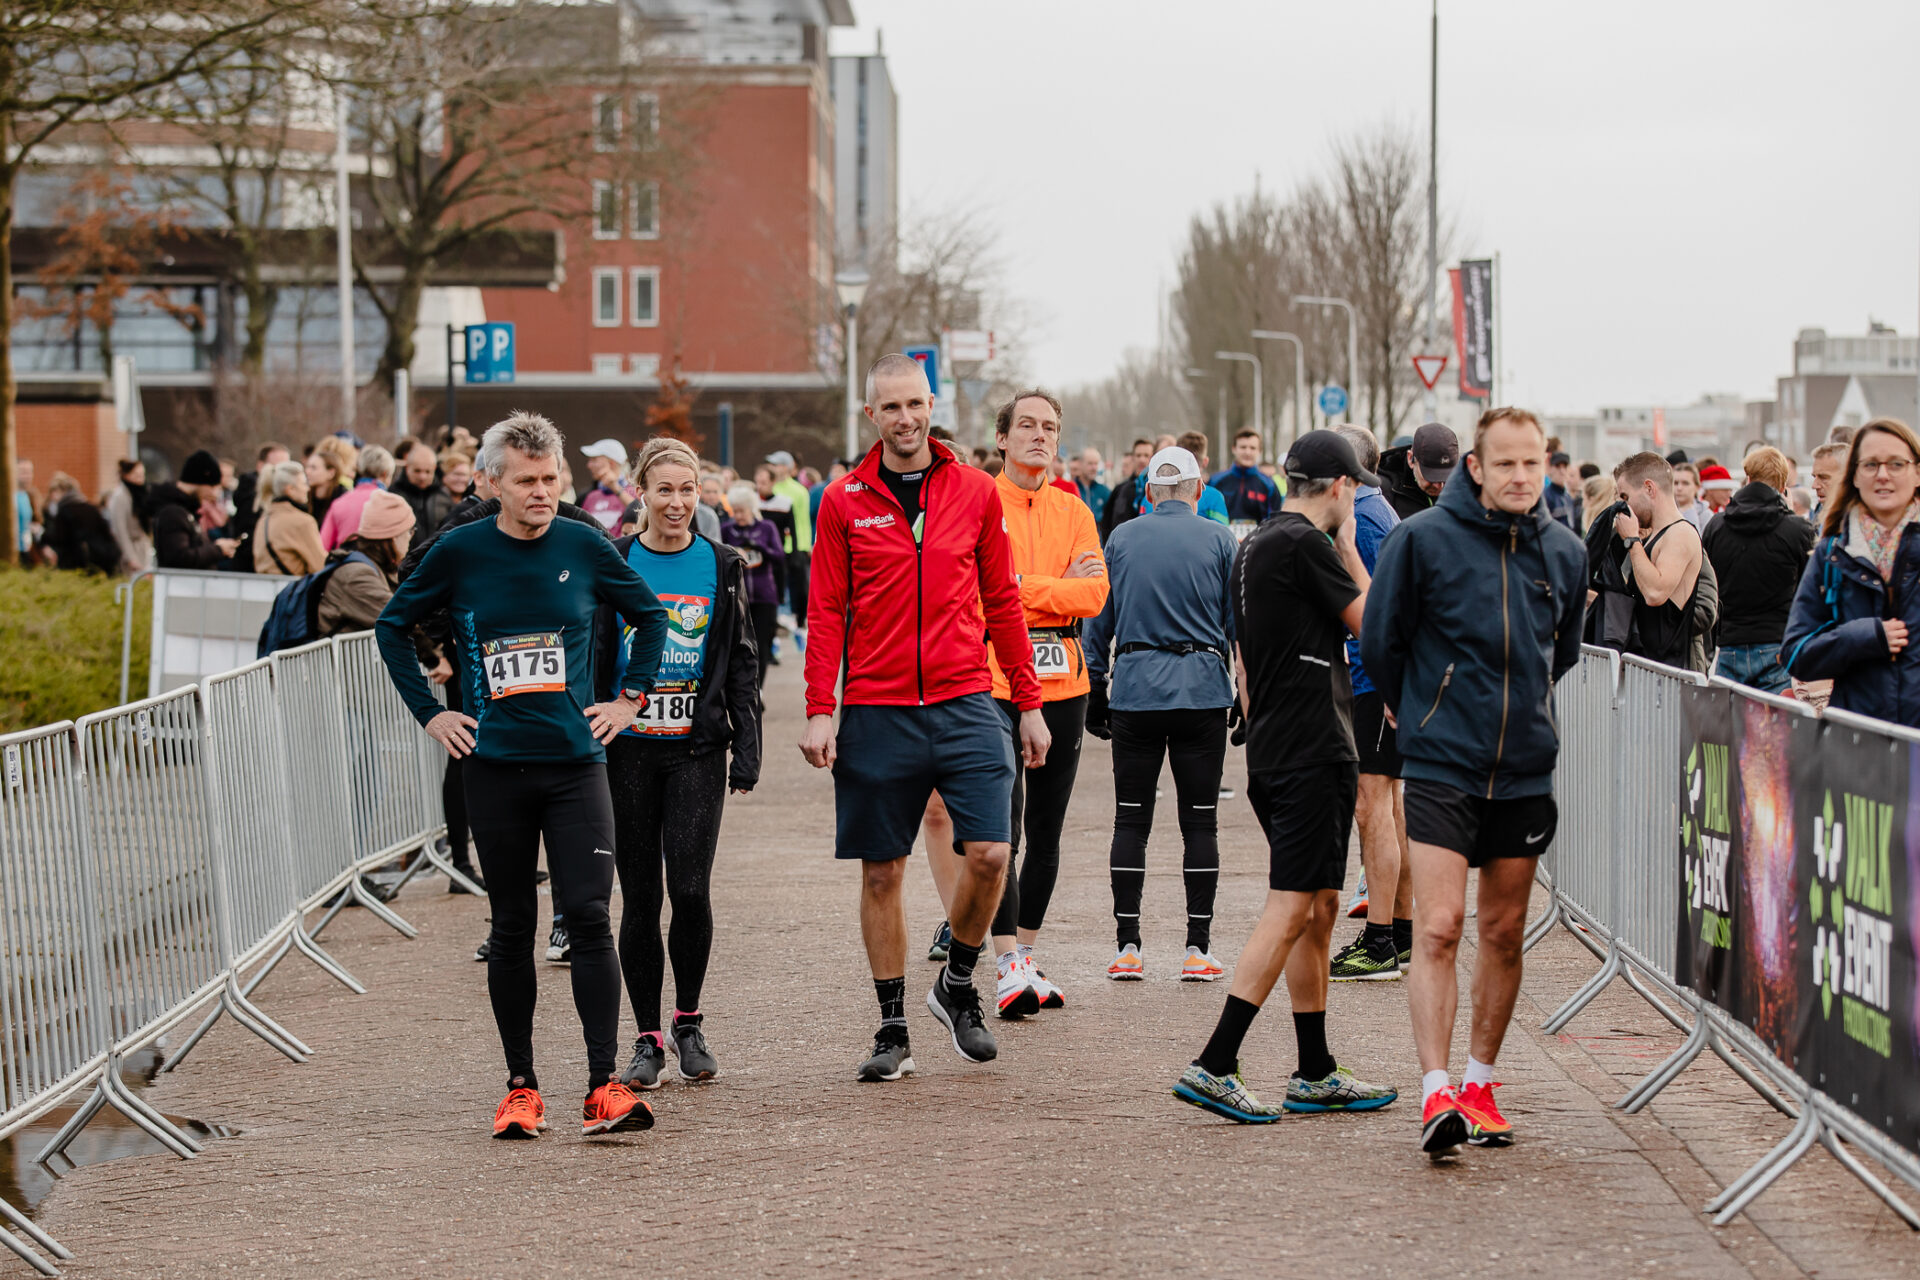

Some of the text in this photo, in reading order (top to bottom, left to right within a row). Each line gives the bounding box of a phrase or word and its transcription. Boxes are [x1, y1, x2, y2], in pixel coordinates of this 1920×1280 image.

[469, 328, 487, 362] P
[492, 327, 510, 362] P
[854, 513, 895, 528] RegioBank
[684, 619, 693, 629] 25
[491, 651, 559, 681] 4175
[636, 696, 696, 720] 2180
[1843, 905, 1893, 1012] EVENT
